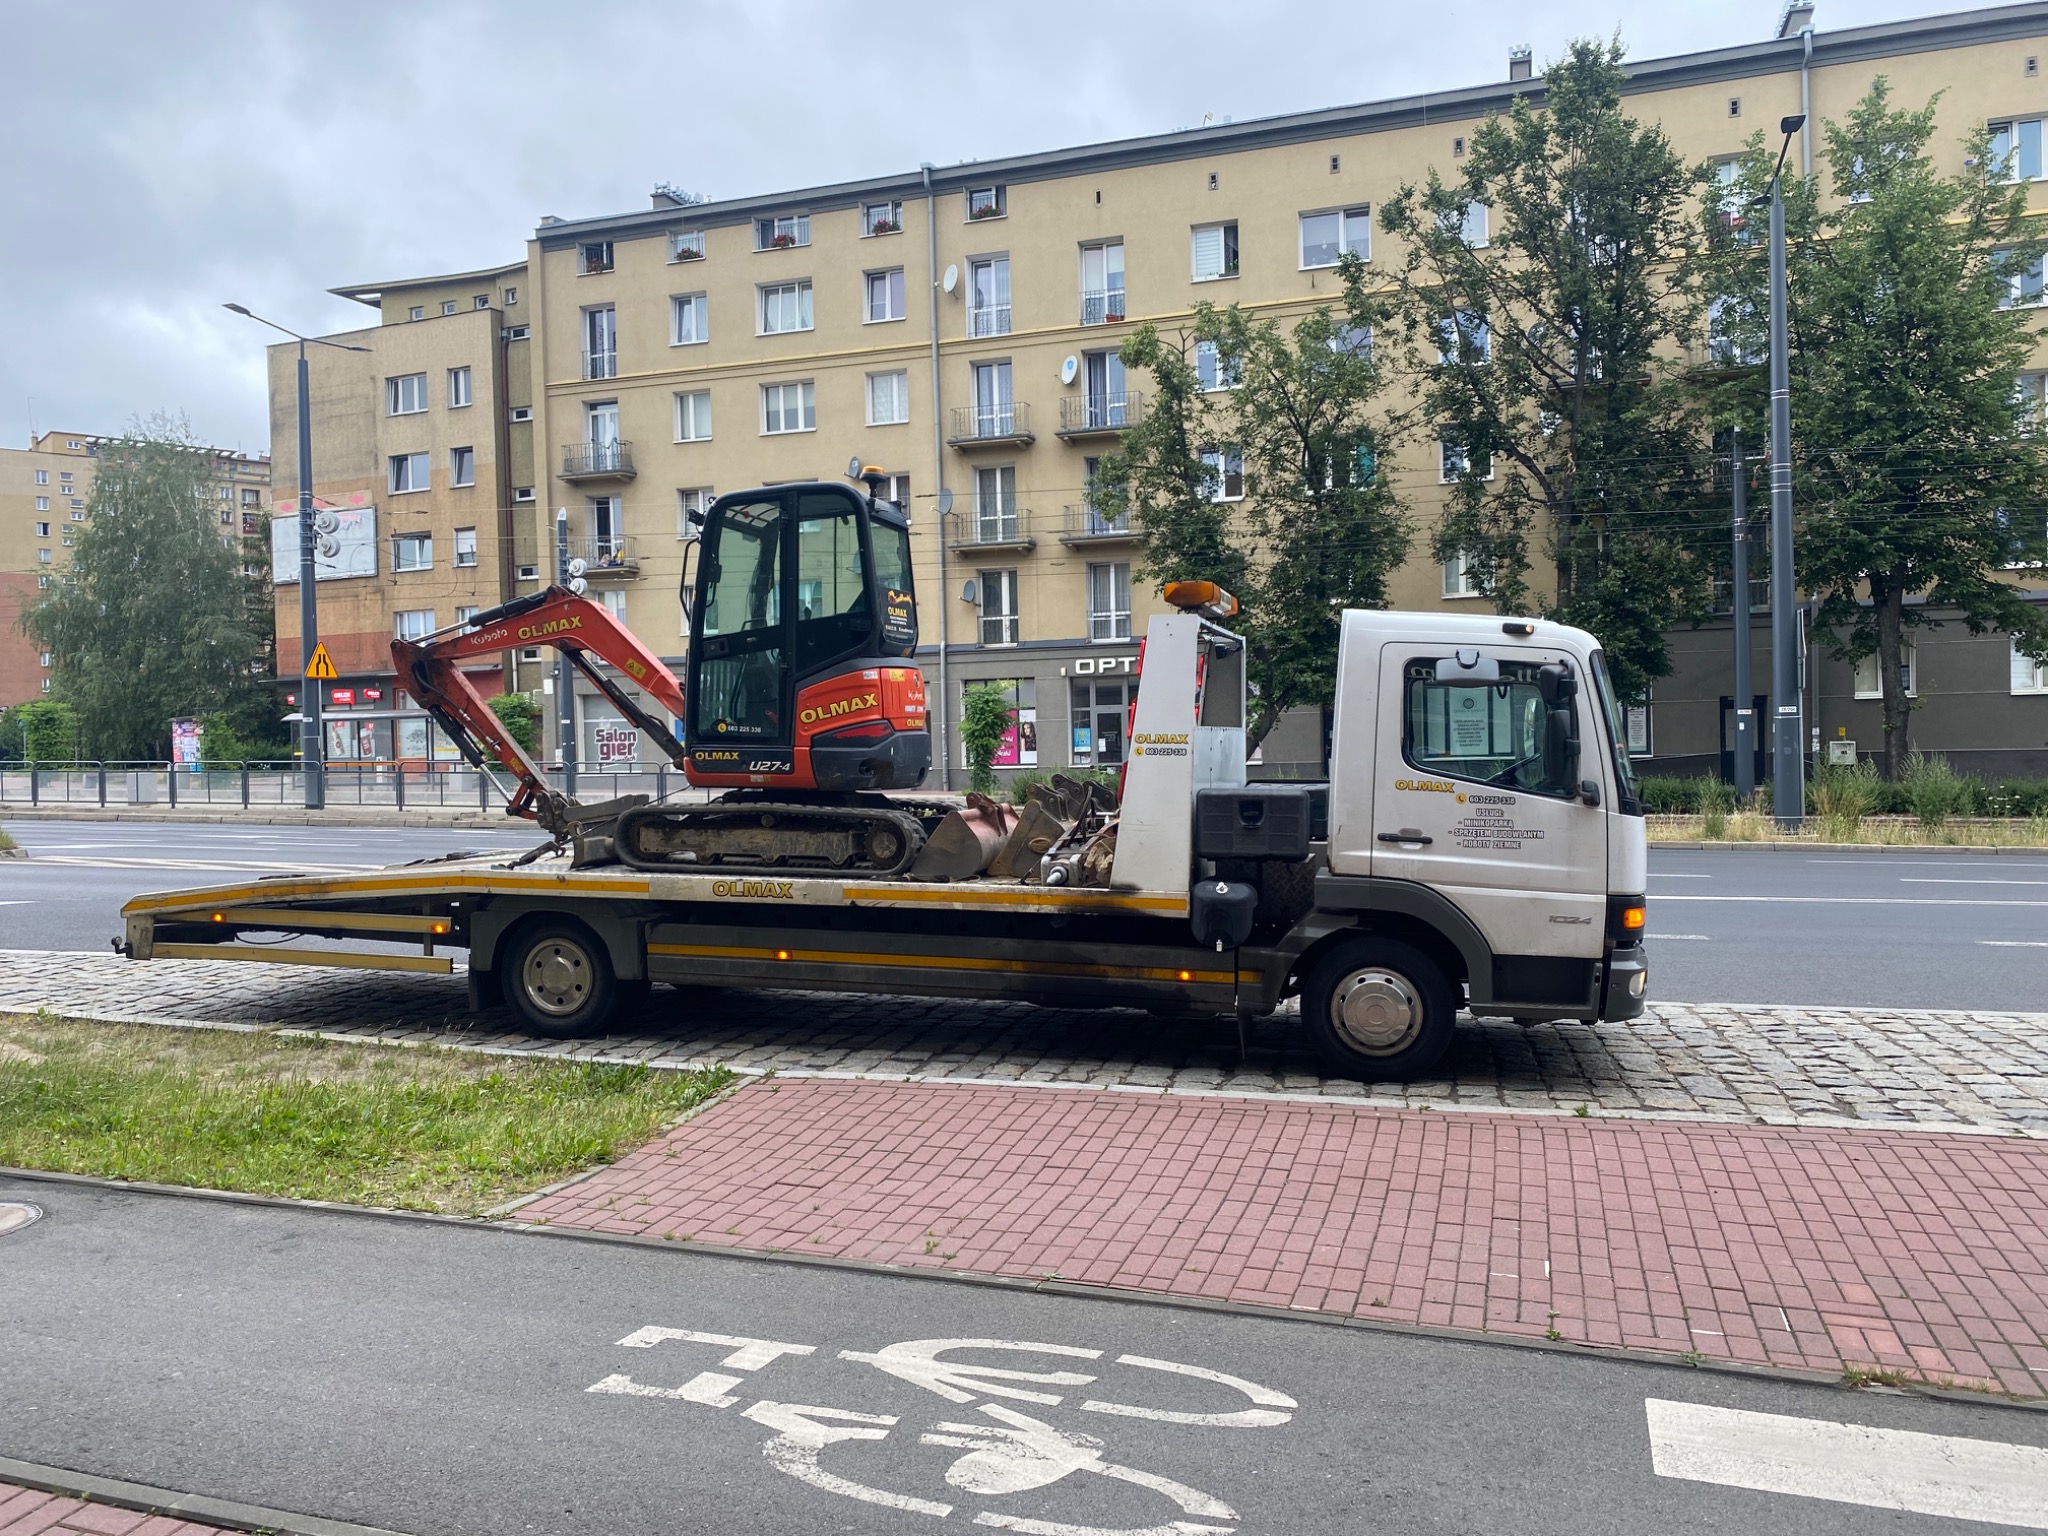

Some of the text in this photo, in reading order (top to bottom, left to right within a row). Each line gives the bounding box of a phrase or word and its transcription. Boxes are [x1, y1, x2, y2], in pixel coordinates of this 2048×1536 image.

[888, 606, 907, 617] OLMAX
[517, 615, 582, 640] OLMAX
[470, 628, 508, 645] Kubota
[1075, 656, 1140, 674] OPT
[799, 692, 879, 724] OLMAX
[595, 728, 637, 743] Salon
[1135, 733, 1189, 744] OLMAX
[600, 743, 636, 761] gier
[695, 751, 739, 760] OLMAX
[1145, 747, 1158, 756] 603
[1159, 747, 1172, 756] 225
[749, 761, 791, 772] U27-4
[1395, 780, 1455, 793] OLMAX
[1469, 795, 1516, 805] 603 225 338
[1463, 818, 1514, 829] MINIKOPARKĄ
[1454, 828, 1491, 838] SPRZĘTEM
[1492, 829, 1544, 839] BUDOWLANYM
[1463, 839, 1490, 848] ROBOTY
[1492, 840, 1521, 849] ZIEMNE
[712, 880, 793, 899] OLMAX
[1549, 915, 1592, 925] 1024
